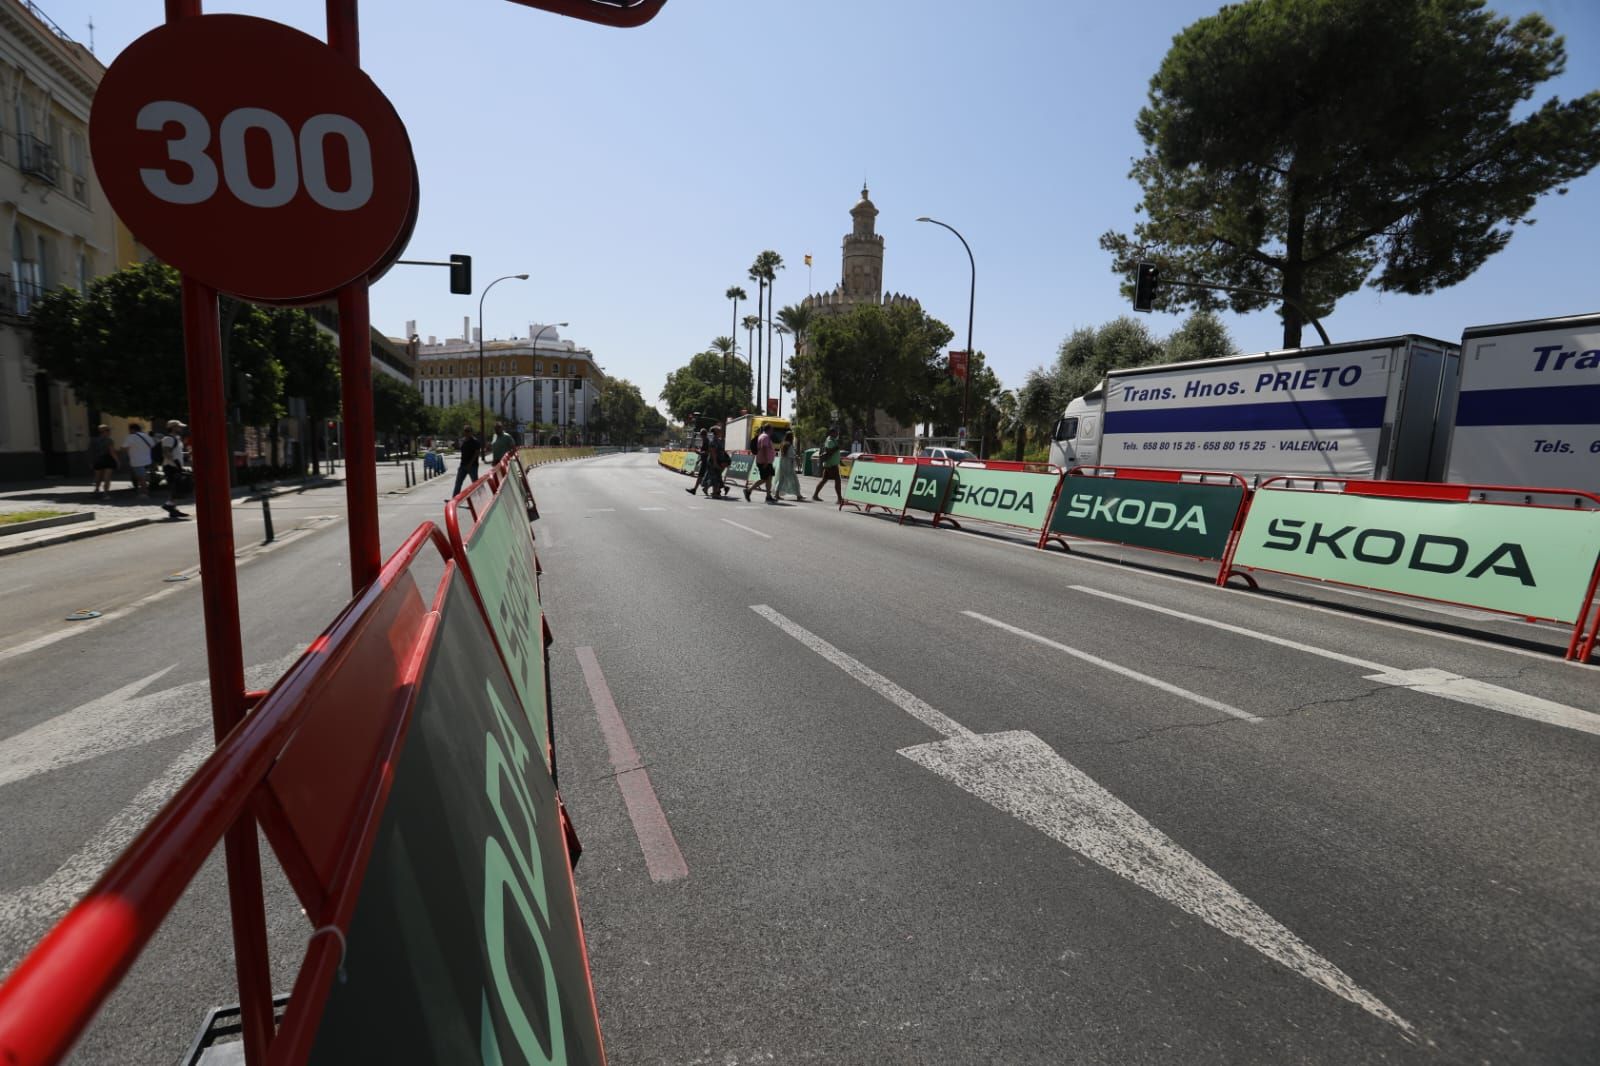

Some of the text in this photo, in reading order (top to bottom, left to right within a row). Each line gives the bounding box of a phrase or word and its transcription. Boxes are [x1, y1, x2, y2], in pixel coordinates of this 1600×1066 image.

[136, 101, 374, 211] 300
[1123, 364, 1362, 403] Trans. Hnos. PRIETO
[1142, 441, 1157, 451] 658
[1159, 441, 1170, 451] 80
[1172, 441, 1182, 451] 15
[1184, 441, 1196, 451] 26
[1203, 441, 1220, 451] 658
[1222, 441, 1235, 451] 80
[1239, 441, 1250, 451] 15
[1252, 441, 1266, 451] 25
[1279, 441, 1339, 451] VALENCIA
[1533, 439, 1575, 454] Tels.
